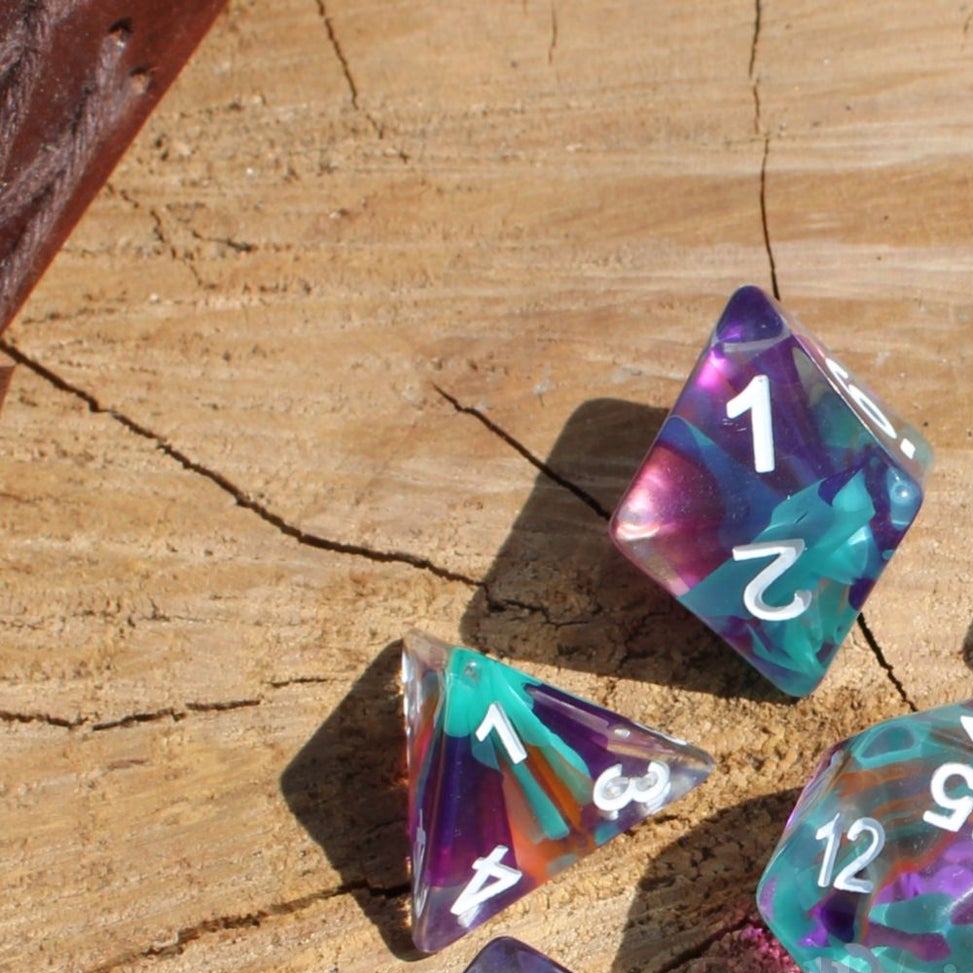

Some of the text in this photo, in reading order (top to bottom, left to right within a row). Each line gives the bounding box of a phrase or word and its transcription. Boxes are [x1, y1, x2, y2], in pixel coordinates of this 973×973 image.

[726, 374, 776, 474] 1
[732, 538, 812, 621] 2
[475, 702, 528, 764] 1
[593, 761, 670, 812] 3
[450, 845, 522, 916] 4
[815, 813, 886, 894] 12
